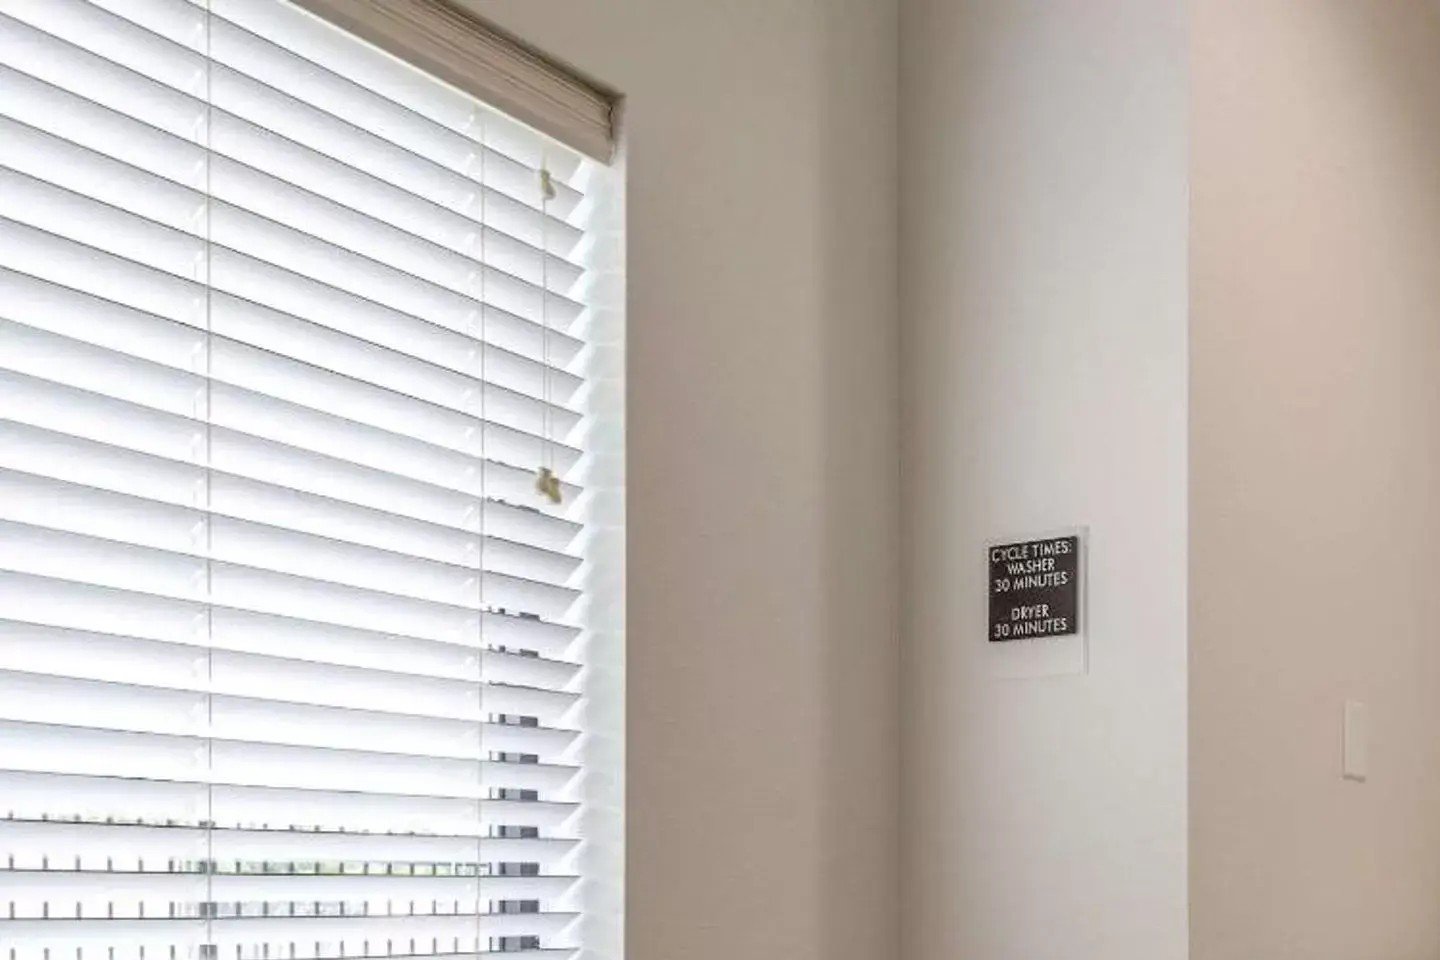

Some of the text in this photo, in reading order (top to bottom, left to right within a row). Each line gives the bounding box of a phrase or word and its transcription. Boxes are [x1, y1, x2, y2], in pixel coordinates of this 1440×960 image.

[992, 540, 1072, 562] CYCLE TIMES:
[1007, 558, 1055, 574] WASHER
[995, 571, 1068, 592] 30 MINUTES
[1011, 604, 1049, 620] DRYER
[994, 617, 1067, 637] 30 MINUTES
